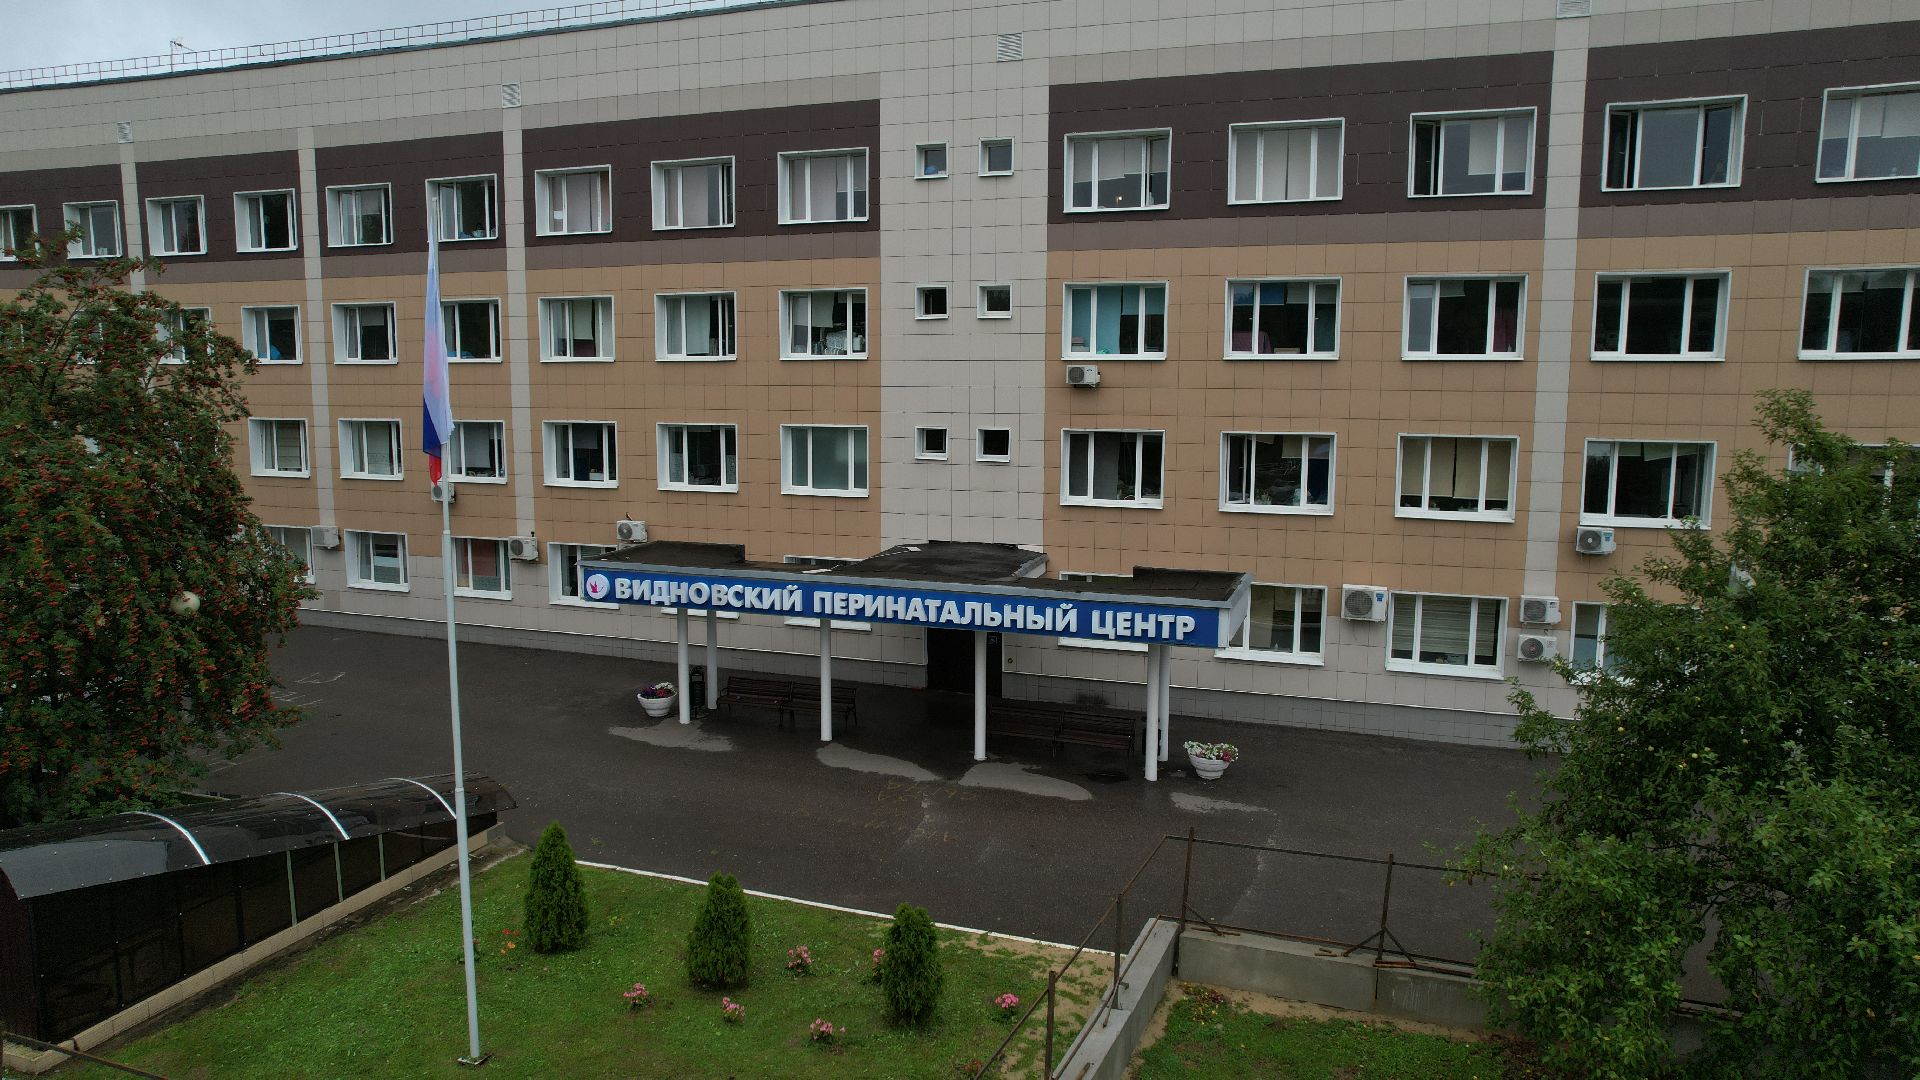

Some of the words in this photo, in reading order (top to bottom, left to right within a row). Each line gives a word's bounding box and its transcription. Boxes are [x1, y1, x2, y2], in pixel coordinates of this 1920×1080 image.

[614, 578, 803, 612] ВИДНОВСКИЙ
[813, 591, 1078, 633] ПЕРИНАТАЛЬНЫЙ
[1091, 610, 1195, 640] ЦЕНТР
